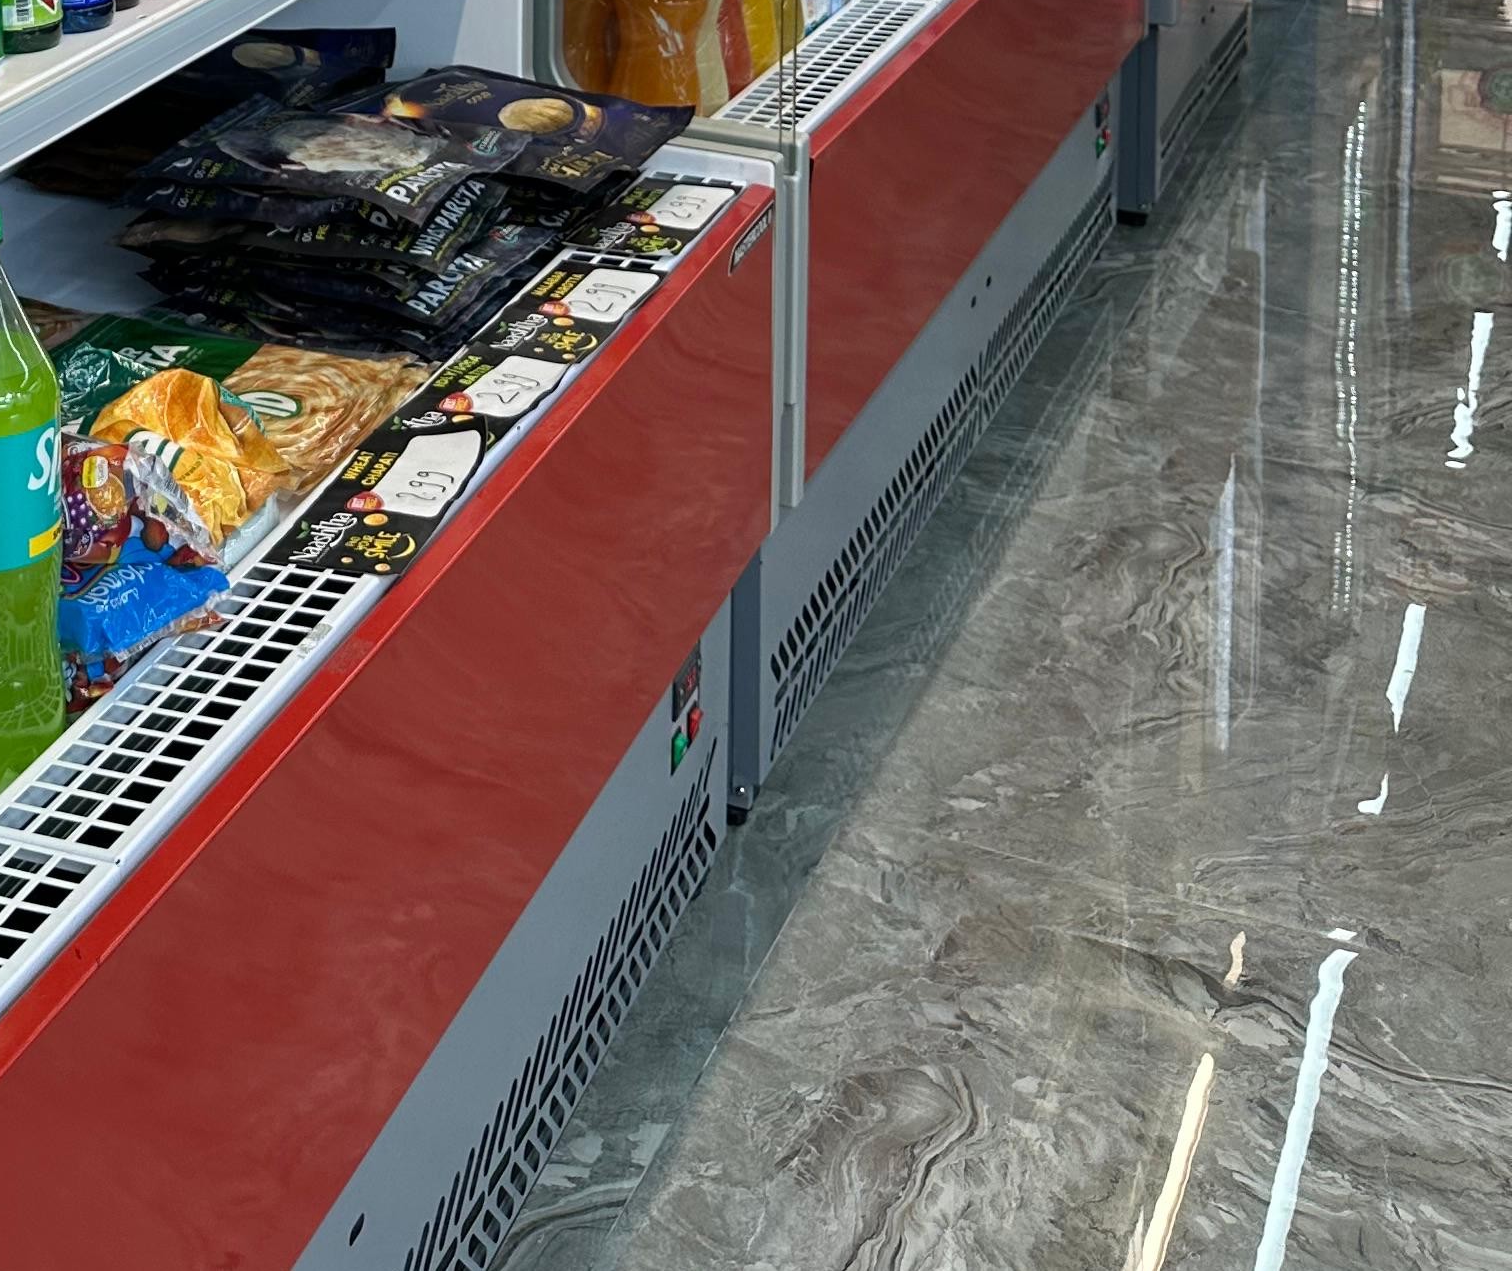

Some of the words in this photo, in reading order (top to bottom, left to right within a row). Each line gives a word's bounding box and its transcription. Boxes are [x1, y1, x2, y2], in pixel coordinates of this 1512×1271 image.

[341, 450, 377, 482] WHEAT
[361, 451, 400, 487] CHAPATI
[363, 530, 402, 559] SMILE
